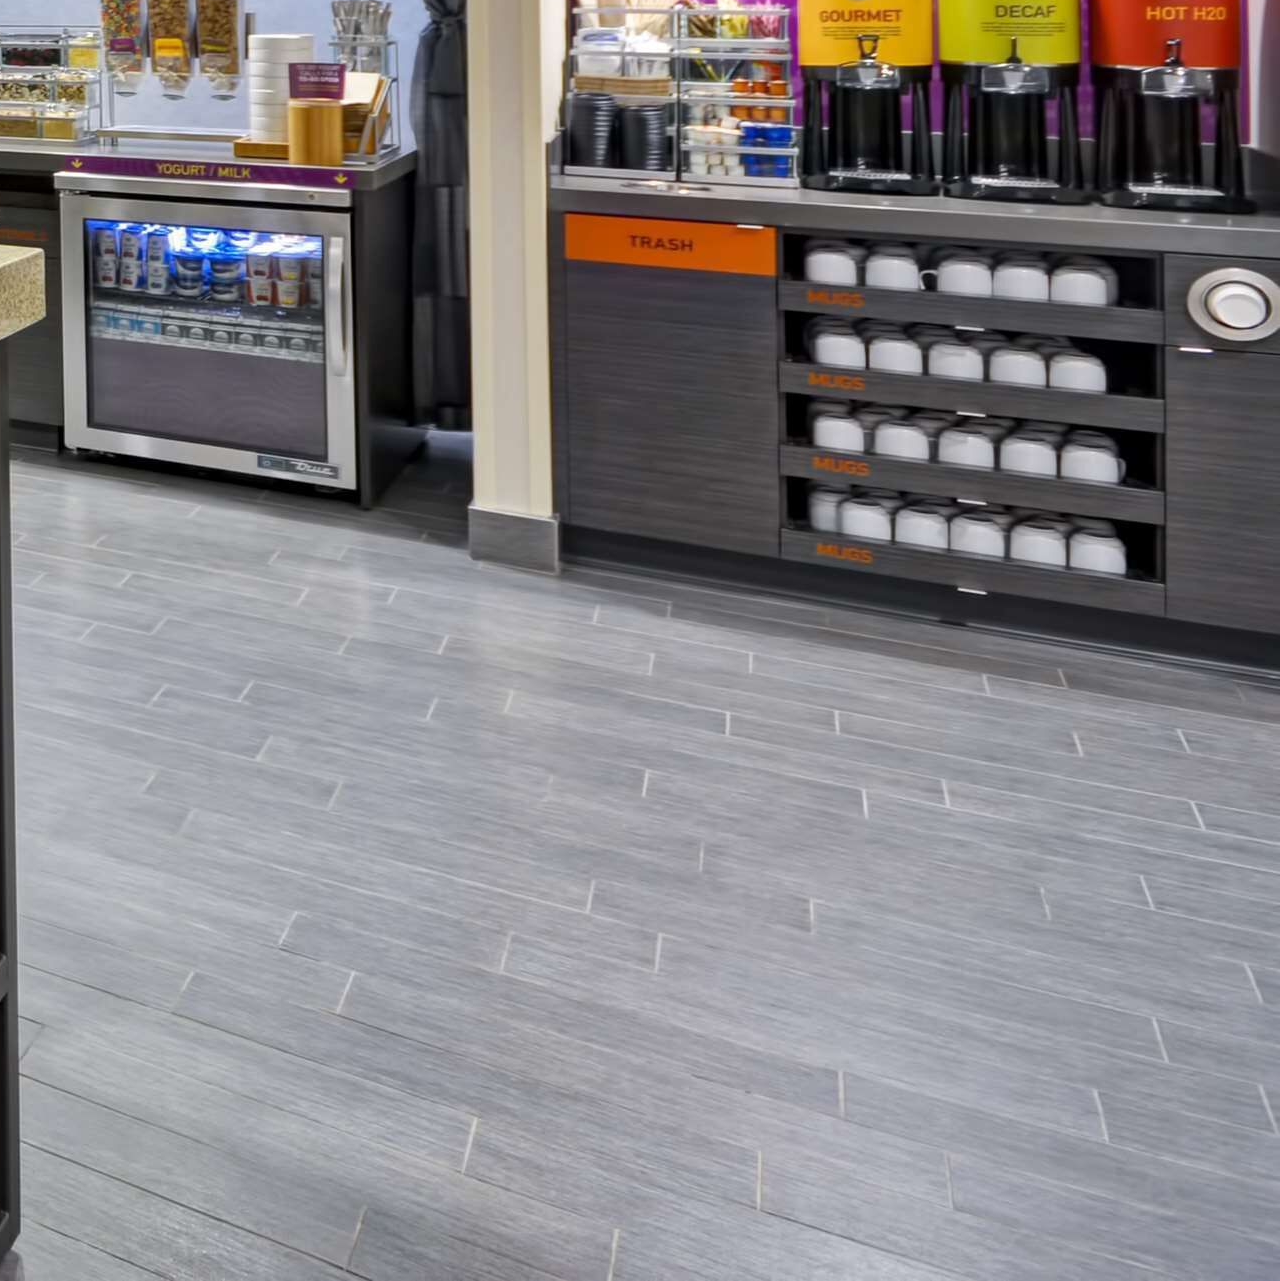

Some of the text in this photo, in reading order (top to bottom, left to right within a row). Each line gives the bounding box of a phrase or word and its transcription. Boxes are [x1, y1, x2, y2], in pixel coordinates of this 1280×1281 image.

[819, 9, 902, 23] GOURMET
[994, 5, 1057, 18] DECAF
[1146, 6, 1189, 21] HOT
[156, 164, 206, 176] YOGURT
[218, 167, 251, 179] MILK
[628, 235, 693, 252] TRASH
[808, 291, 865, 308] MUGS
[808, 372, 865, 390] MUGS
[813, 456, 870, 476] MUGS
[816, 543, 873, 563] MUGS
